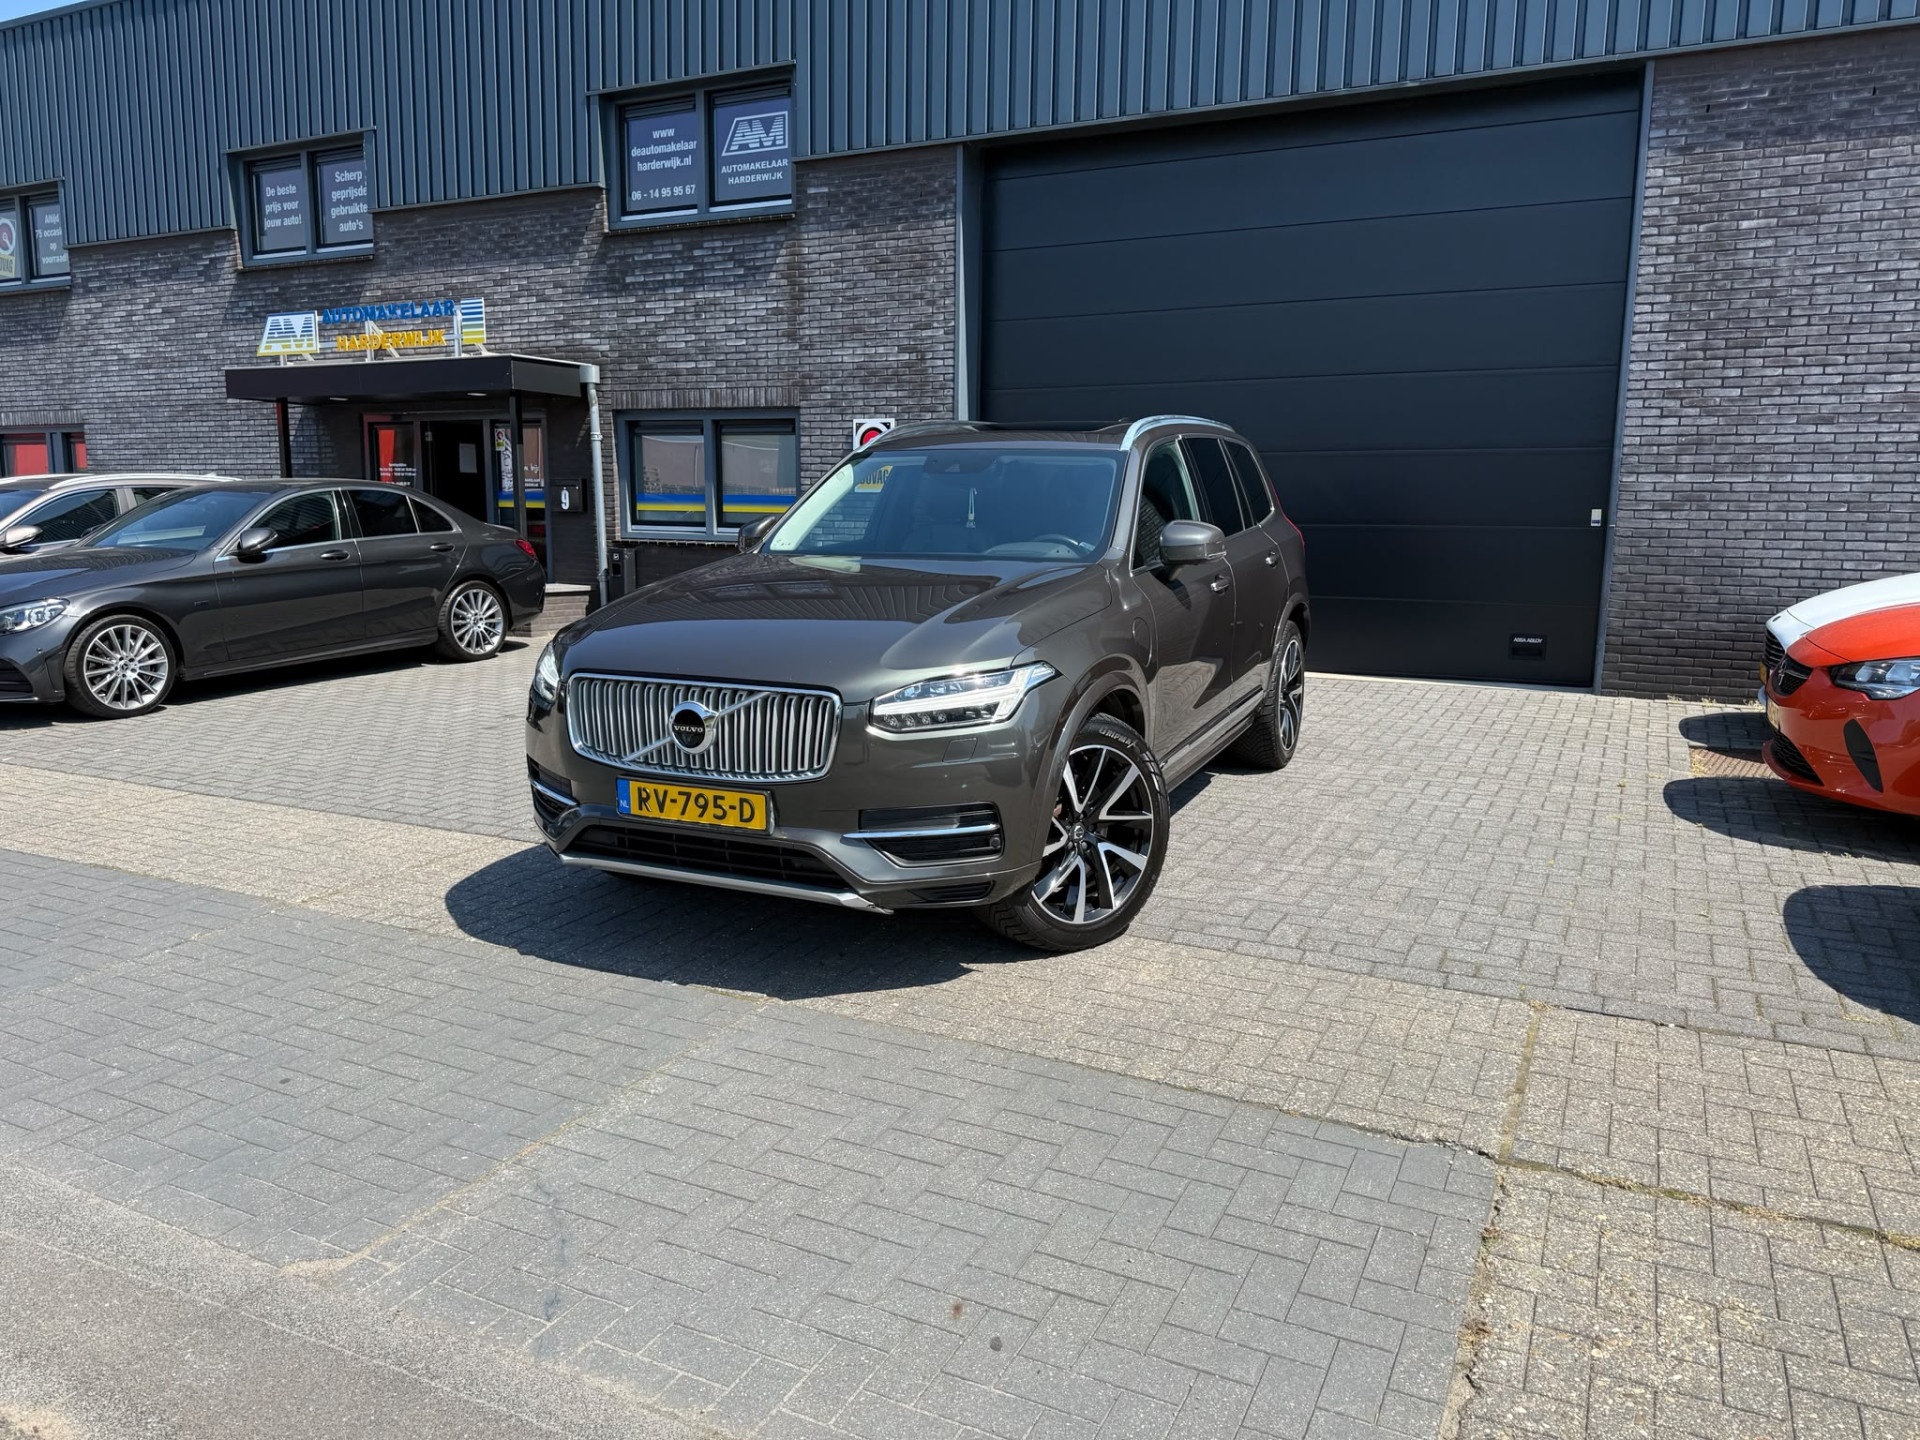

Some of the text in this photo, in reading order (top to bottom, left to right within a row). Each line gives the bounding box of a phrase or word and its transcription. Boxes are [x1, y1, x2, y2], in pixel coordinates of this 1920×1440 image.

[652, 128, 675, 138] www
[631, 140, 697, 157] deautomakelaar
[637, 155, 692, 172] harderwijk.nl
[721, 158, 788, 174] AUTOMAKELAAR
[334, 170, 362, 183] Scherp
[728, 171, 783, 185] HARDERWIJK
[266, 184, 296, 196] De beste
[332, 185, 368, 202] geprijsde
[632, 190, 642, 200] 06
[649, 188, 660, 198] 14
[661, 187, 672, 198] 95
[673, 186, 684, 196] 95
[685, 184, 696, 195] 67
[265, 200, 299, 215] prijs voor
[331, 203, 368, 218] gebruikte
[264, 214, 302, 230] jouw auto!
[339, 220, 364, 232] auto's
[322, 300, 457, 324] AUTOMAKELAAR
[336, 330, 446, 352] HARDERWIJK
[562, 490, 570, 510] 9
[674, 725, 704, 733] VOLVO
[620, 786, 756, 824] NL RV-795-D
